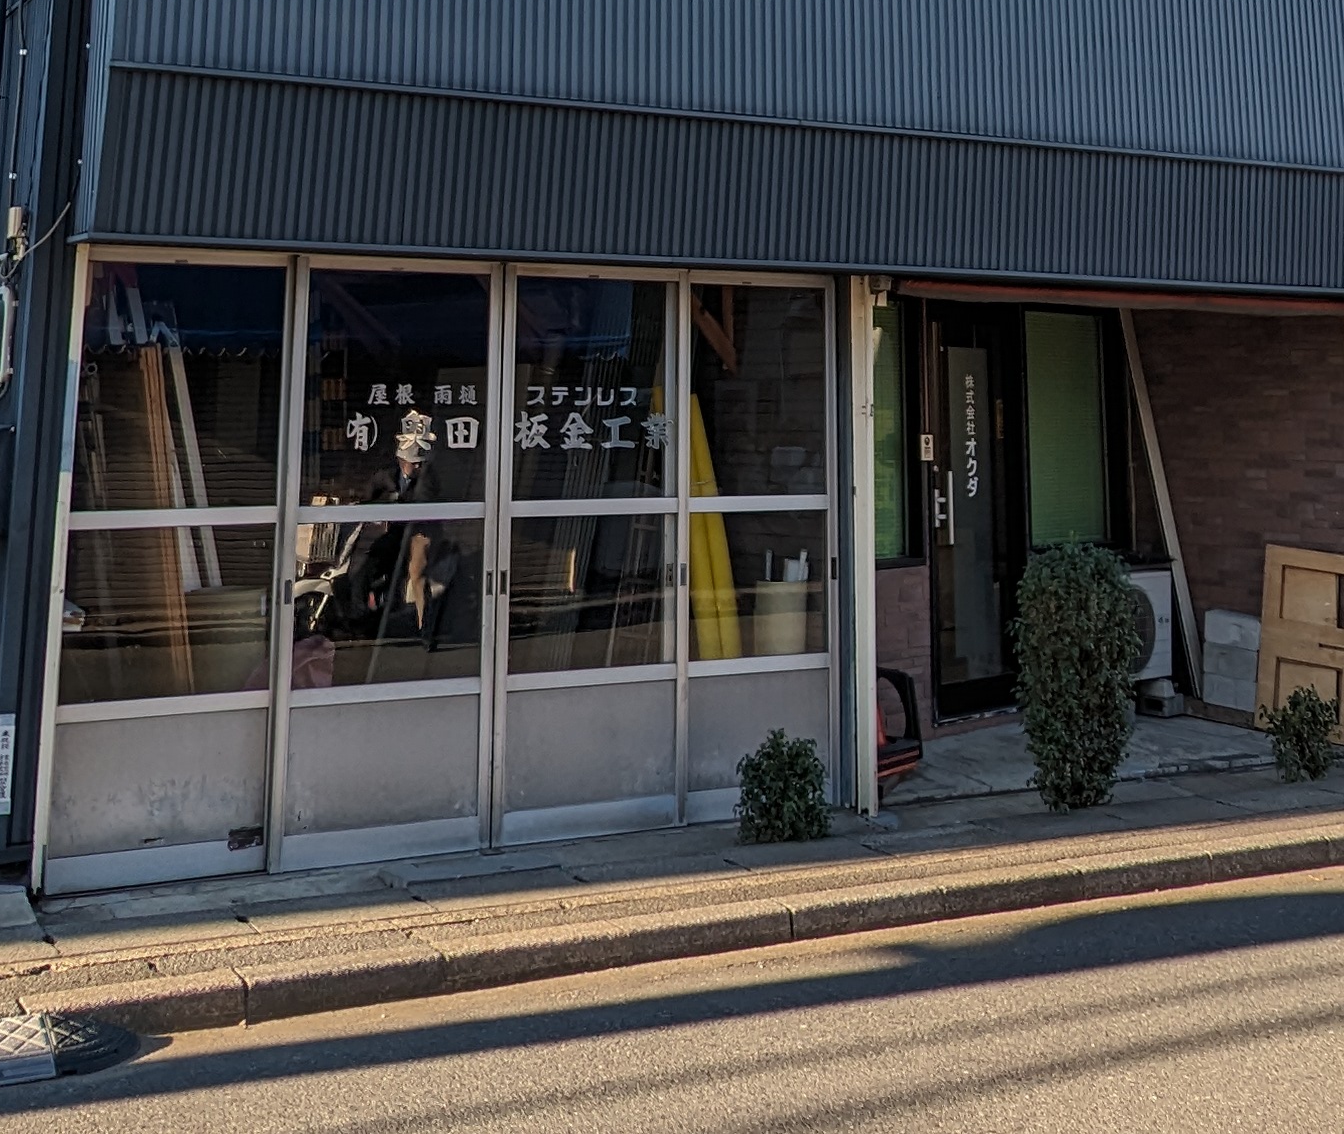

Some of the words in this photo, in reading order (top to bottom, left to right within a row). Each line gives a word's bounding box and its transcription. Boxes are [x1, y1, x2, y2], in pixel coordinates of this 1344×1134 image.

[368, 383, 415, 405] 屋根
[527, 386, 637, 406] ステンレス
